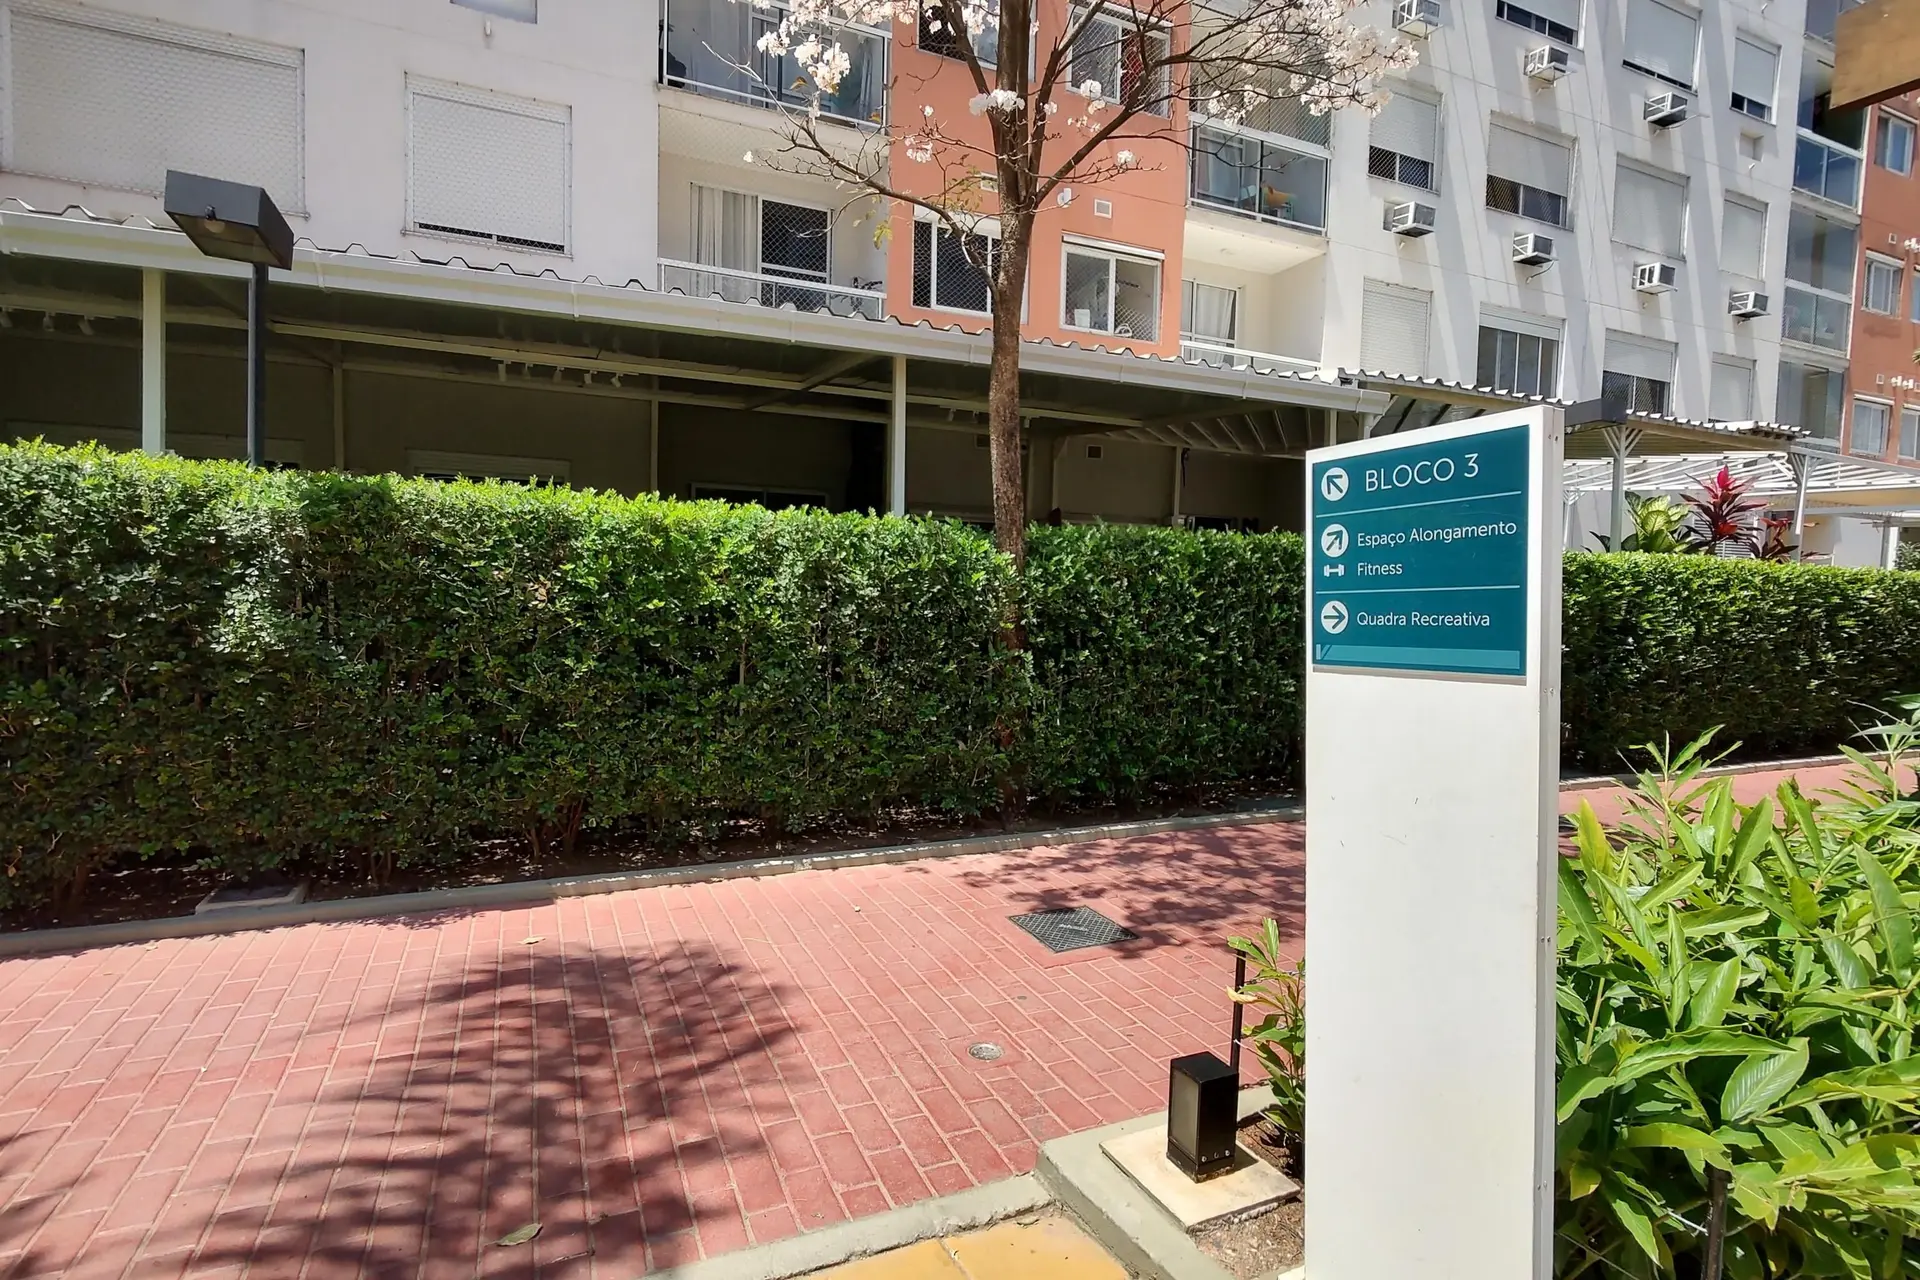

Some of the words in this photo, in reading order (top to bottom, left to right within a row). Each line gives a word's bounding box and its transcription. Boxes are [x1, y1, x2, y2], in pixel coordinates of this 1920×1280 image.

[1365, 457, 1455, 492] BLOCO
[1463, 452, 1479, 478] 3
[1357, 532, 1406, 549] Espaço
[1409, 521, 1517, 544] Alongamento
[1357, 562, 1403, 576] Fitness
[1356, 612, 1407, 628] Quadra
[1411, 611, 1490, 627] Recreativa
